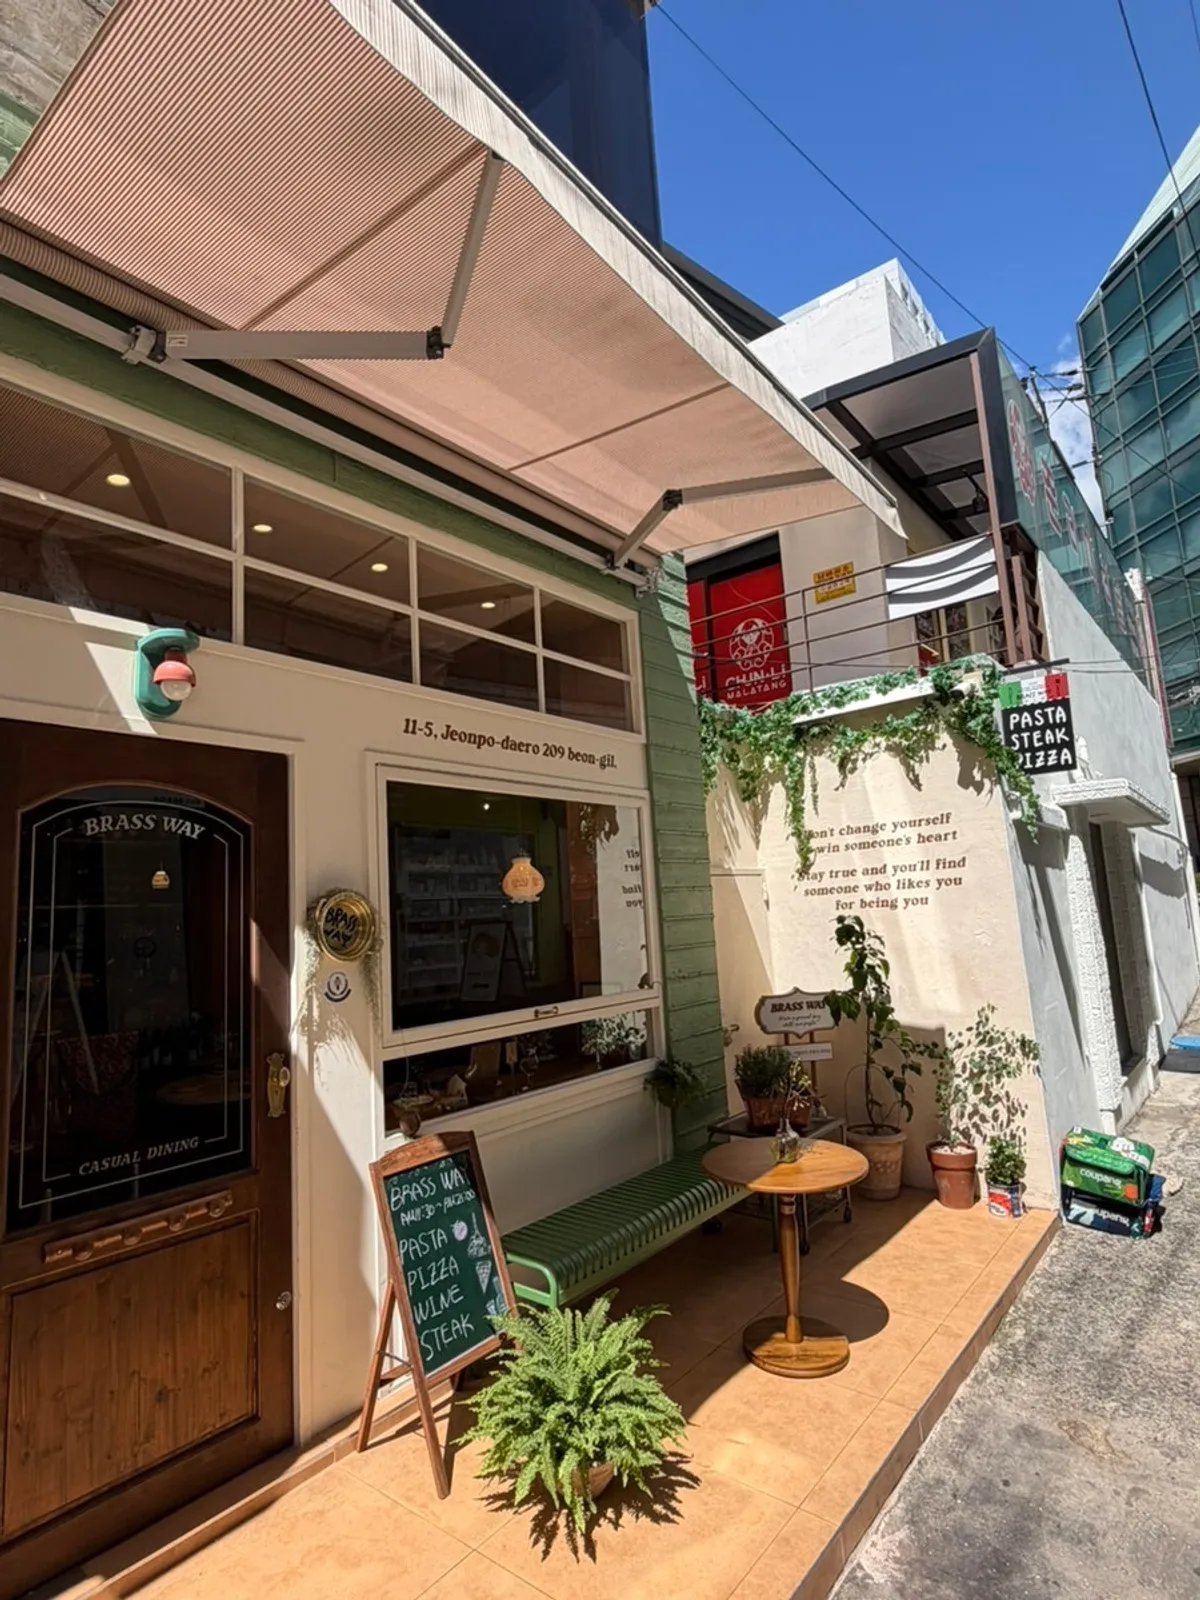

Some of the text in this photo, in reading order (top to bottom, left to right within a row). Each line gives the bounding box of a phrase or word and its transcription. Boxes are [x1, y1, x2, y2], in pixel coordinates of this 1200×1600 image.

[726, 678, 787, 699] MALATANG
[1009, 706, 1067, 731] PASTA
[402, 718, 438, 740] 11-5,
[441, 724, 540, 756] Jeonpo-daero
[542, 742, 565, 759] 209
[1010, 727, 1070, 751] STEAK
[84, 814, 206, 840] BRASS WAY
[838, 822, 887, 836] change
[891, 812, 953, 833] yourself
[843, 834, 911, 852] someone's
[916, 830, 958, 845] heart
[829, 868, 858, 880] true
[861, 863, 888, 876] and
[891, 859, 931, 877] you'll
[935, 856, 967, 870] find
[803, 876, 963, 897] someone who likes you
[835, 896, 929, 911] for being you
[325, 906, 358, 932] BRASS
[323, 928, 353, 948] WAY
[770, 1000, 804, 1013] BRASS
[78, 1136, 200, 1176] CASUAL DINING
[1079, 1167, 1122, 1190] coupang
[390, 1176, 436, 1212] BRASS
[399, 1228, 448, 1266] PASTA
[407, 1255, 460, 1297] PIZZA
[413, 1283, 465, 1325] WINE
[420, 1312, 475, 1362] STEAK
